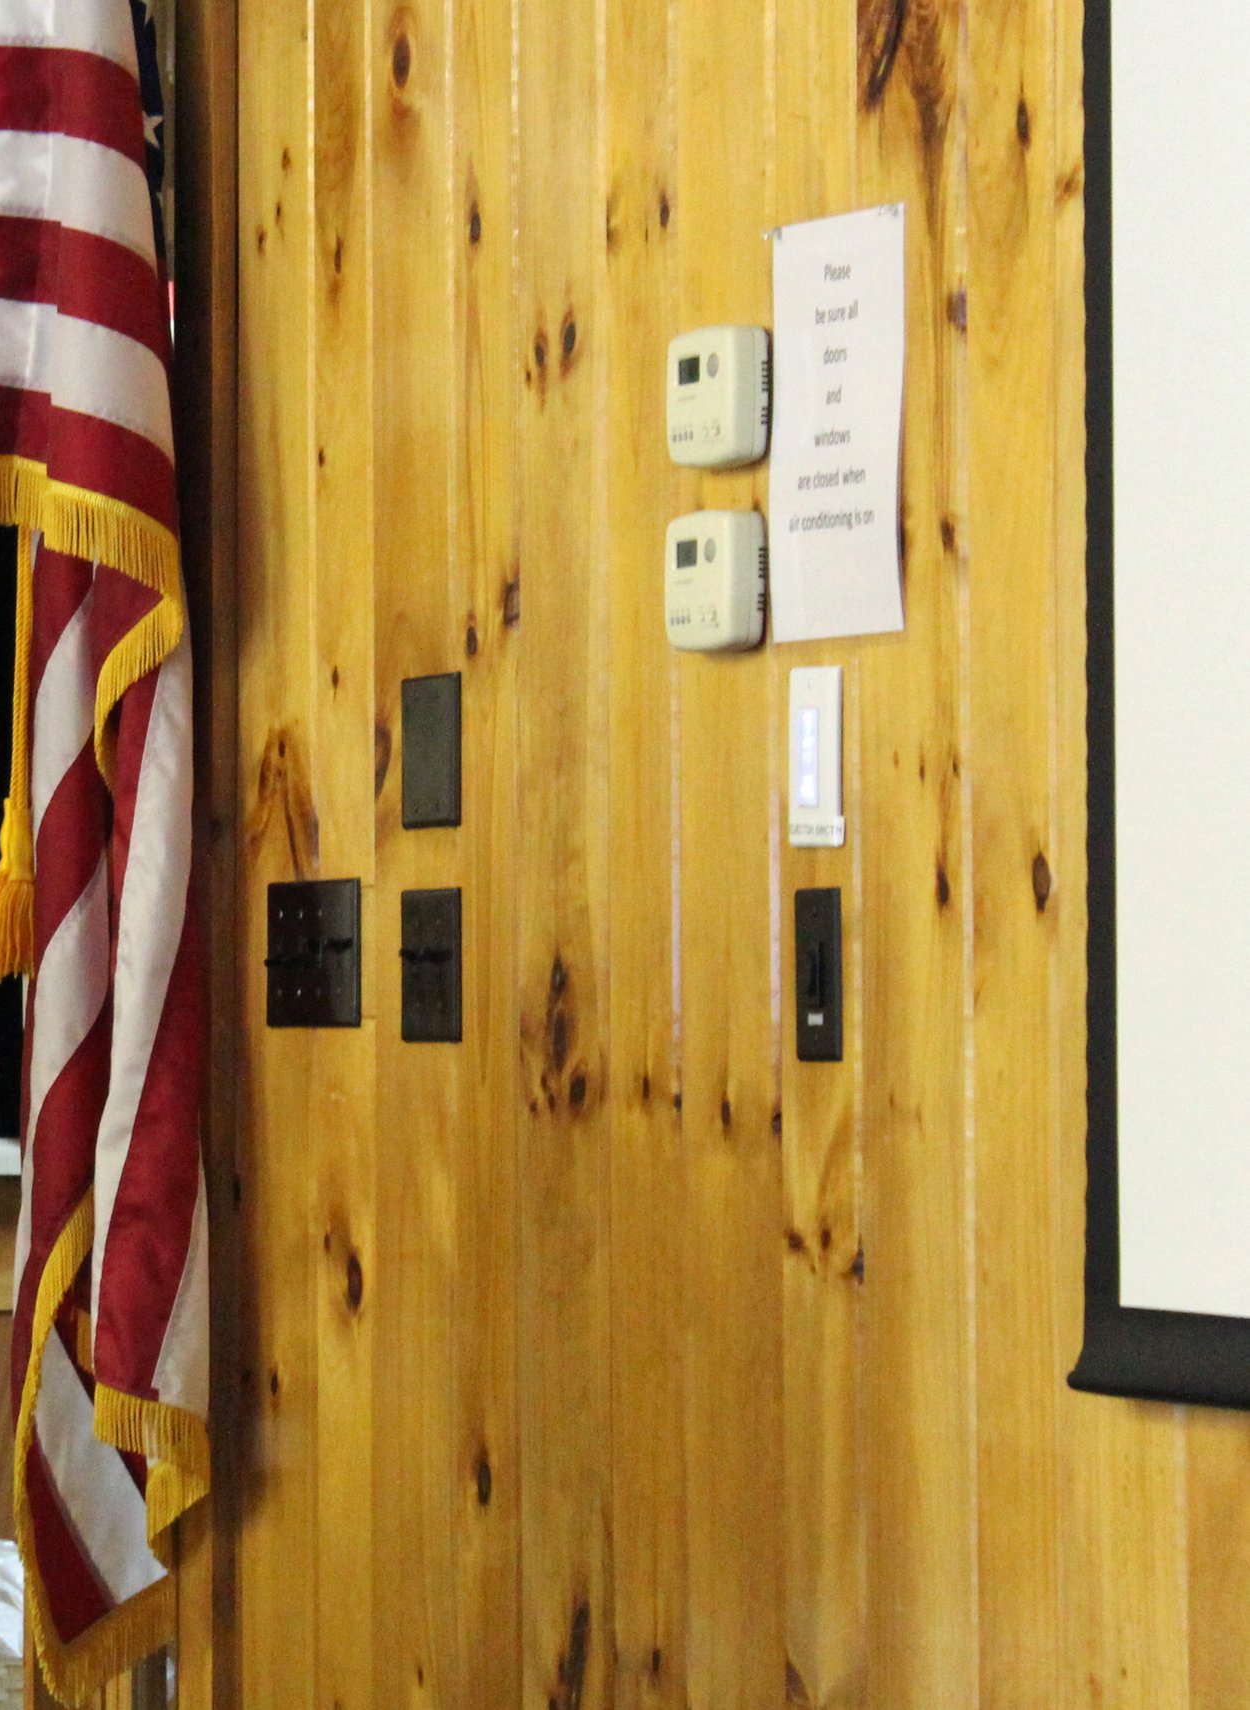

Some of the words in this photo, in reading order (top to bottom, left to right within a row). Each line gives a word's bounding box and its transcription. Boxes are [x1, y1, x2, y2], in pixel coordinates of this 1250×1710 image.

[823, 263, 852, 282] Please
[815, 306, 826, 325] be
[827, 306, 846, 324] sure
[847, 299, 859, 320] all
[823, 346, 848, 365] doors
[826, 385, 842, 405] and
[814, 427, 851, 447] windows
[797, 475, 811, 491] are
[813, 467, 840, 490] closed
[842, 466, 866, 485] when
[789, 516, 800, 533] air
[802, 509, 853, 532] conditioning
[854, 506, 861, 525] is
[863, 509, 874, 525] on
